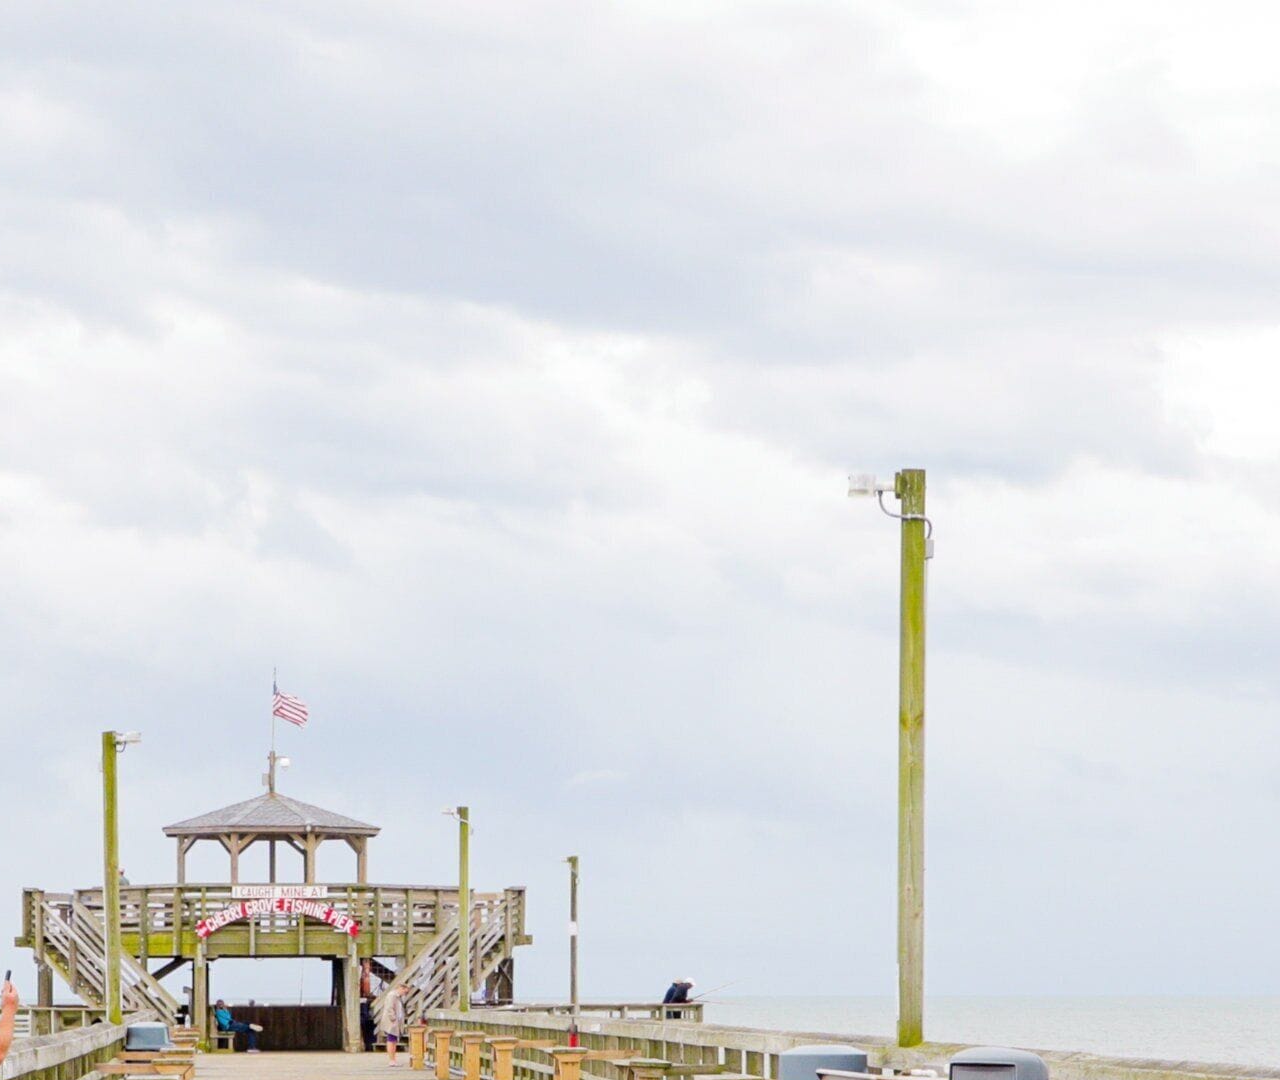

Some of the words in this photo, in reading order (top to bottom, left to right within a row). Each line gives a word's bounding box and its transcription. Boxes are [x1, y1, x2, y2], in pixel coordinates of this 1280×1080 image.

[240, 887, 275, 898] CAUGHT
[281, 887, 307, 898] MINE
[311, 887, 325, 897] AT
[206, 903, 243, 932] CHERRY
[245, 898, 281, 914] GROVE
[284, 898, 329, 919] FISHING
[328, 911, 354, 933] PIER
